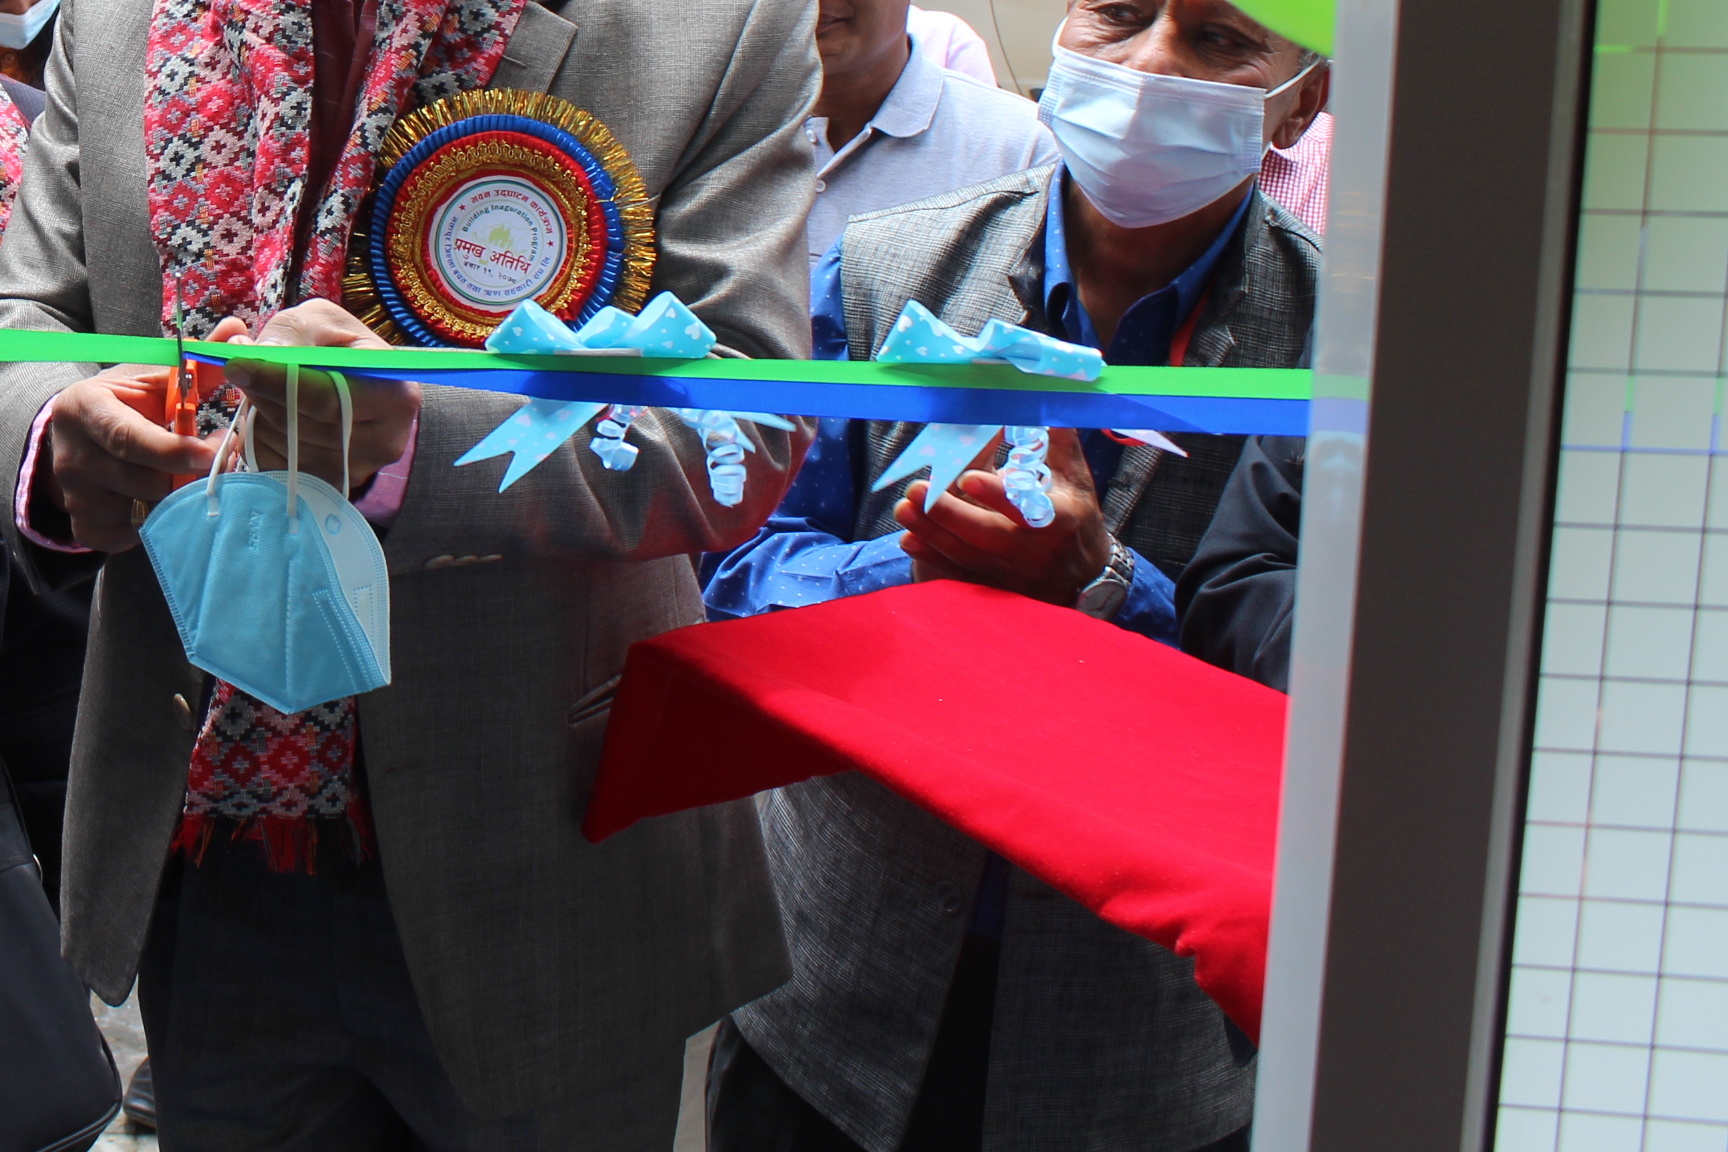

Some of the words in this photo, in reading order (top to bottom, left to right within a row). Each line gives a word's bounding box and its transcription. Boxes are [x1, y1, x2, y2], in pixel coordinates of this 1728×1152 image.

[453, 238, 486, 259] प्रमुख
[489, 250, 532, 274] अतिथि
[462, 205, 489, 232] Building
[491, 204, 533, 226] Inaguration
[528, 227, 538, 262] Program
